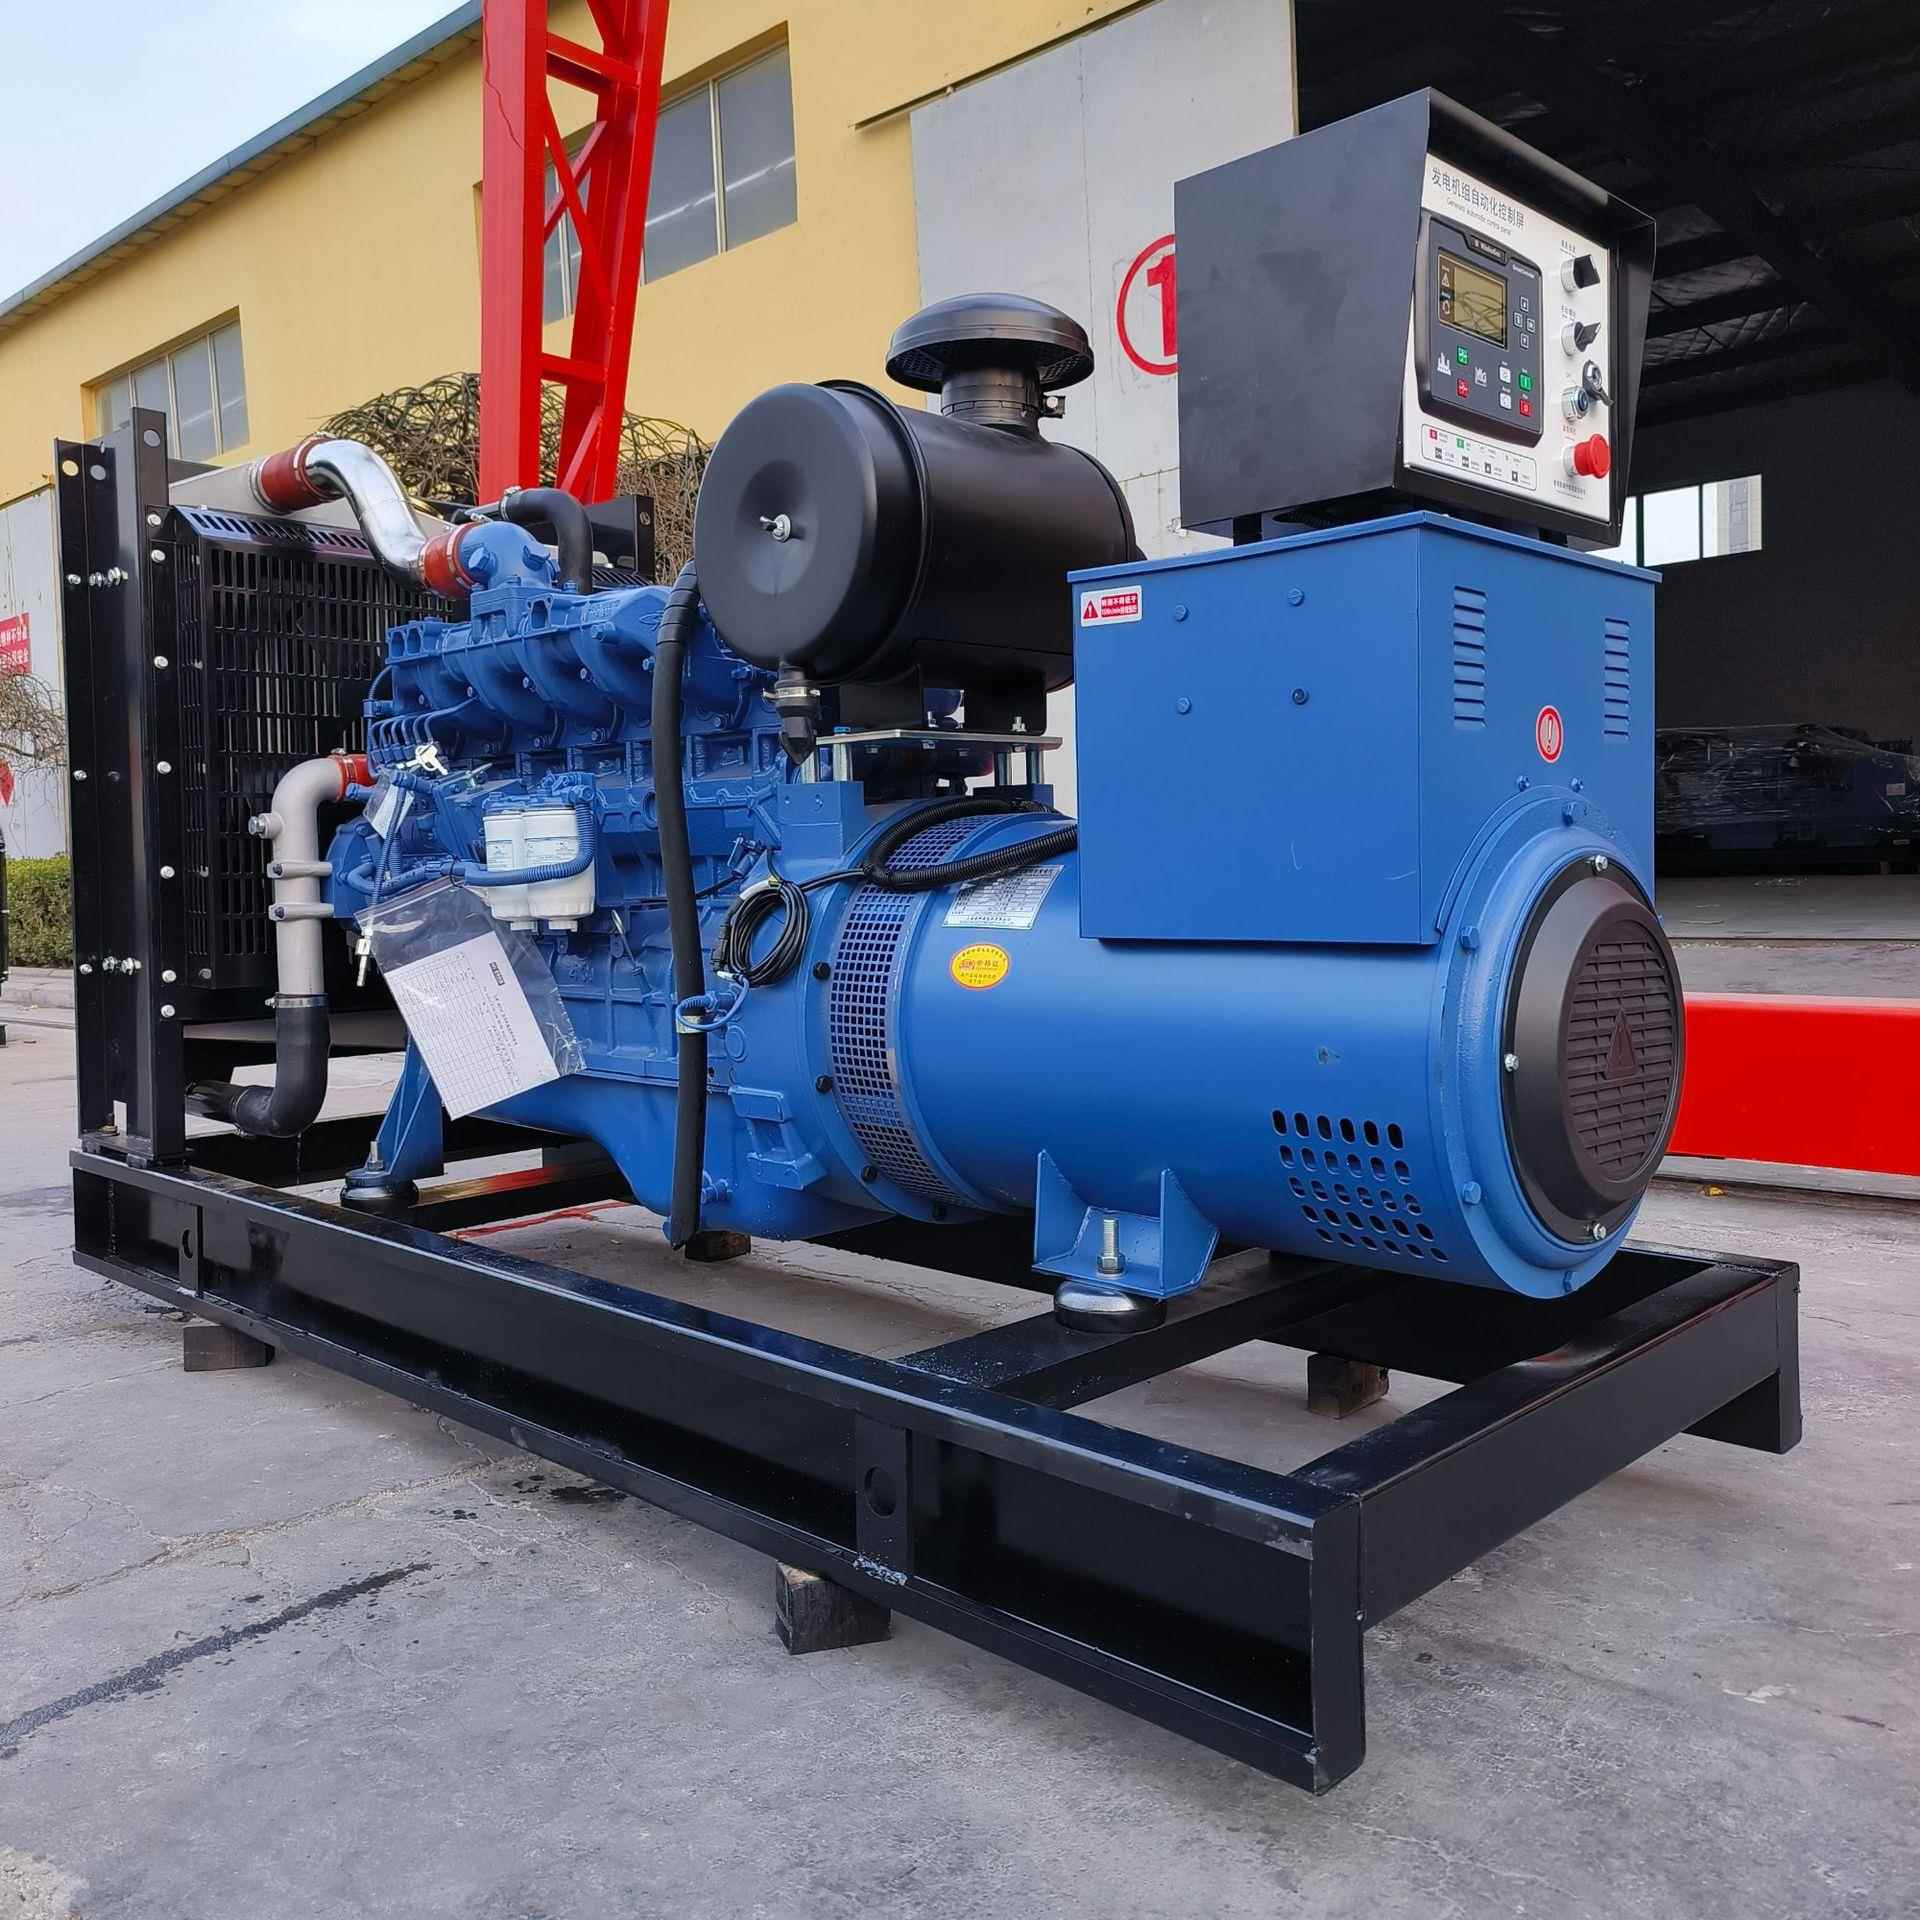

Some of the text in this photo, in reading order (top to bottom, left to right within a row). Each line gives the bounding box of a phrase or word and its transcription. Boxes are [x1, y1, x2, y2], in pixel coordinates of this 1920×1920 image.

[1432, 167, 1525, 228] 发电机组自动化控制屏
[1147, 254, 1177, 357] 1
